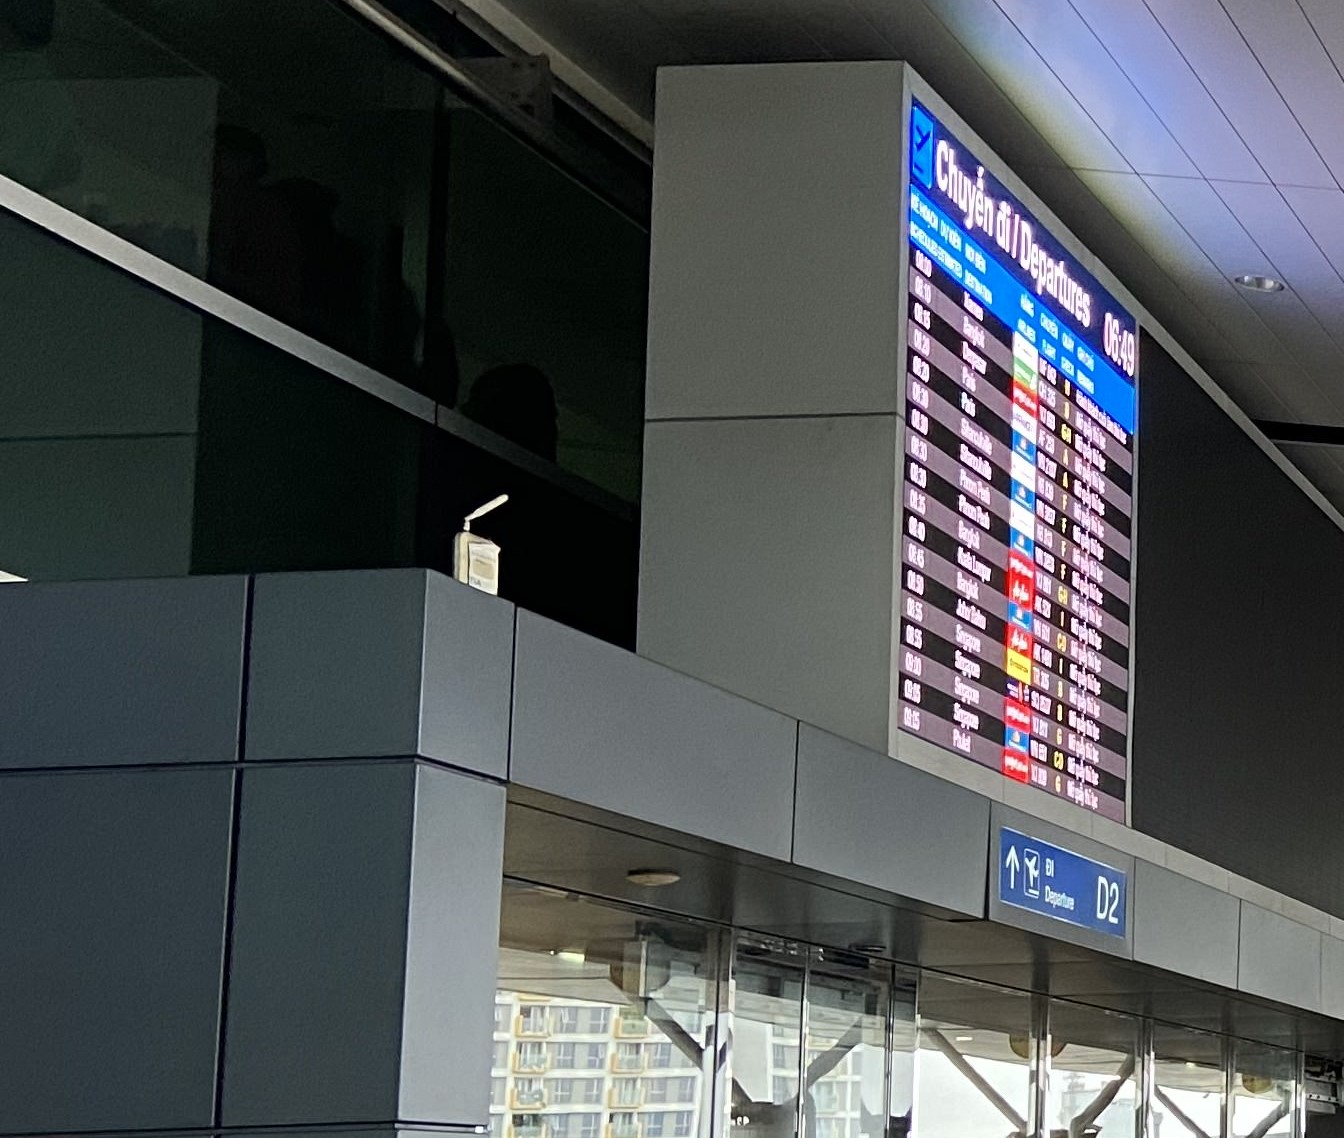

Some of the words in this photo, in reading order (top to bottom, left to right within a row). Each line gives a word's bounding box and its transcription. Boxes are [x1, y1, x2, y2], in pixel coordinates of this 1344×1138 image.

[1020, 219, 1092, 328] Departures
[1103, 312, 1135, 378] 06:49
[1096, 875, 1119, 925] D2
